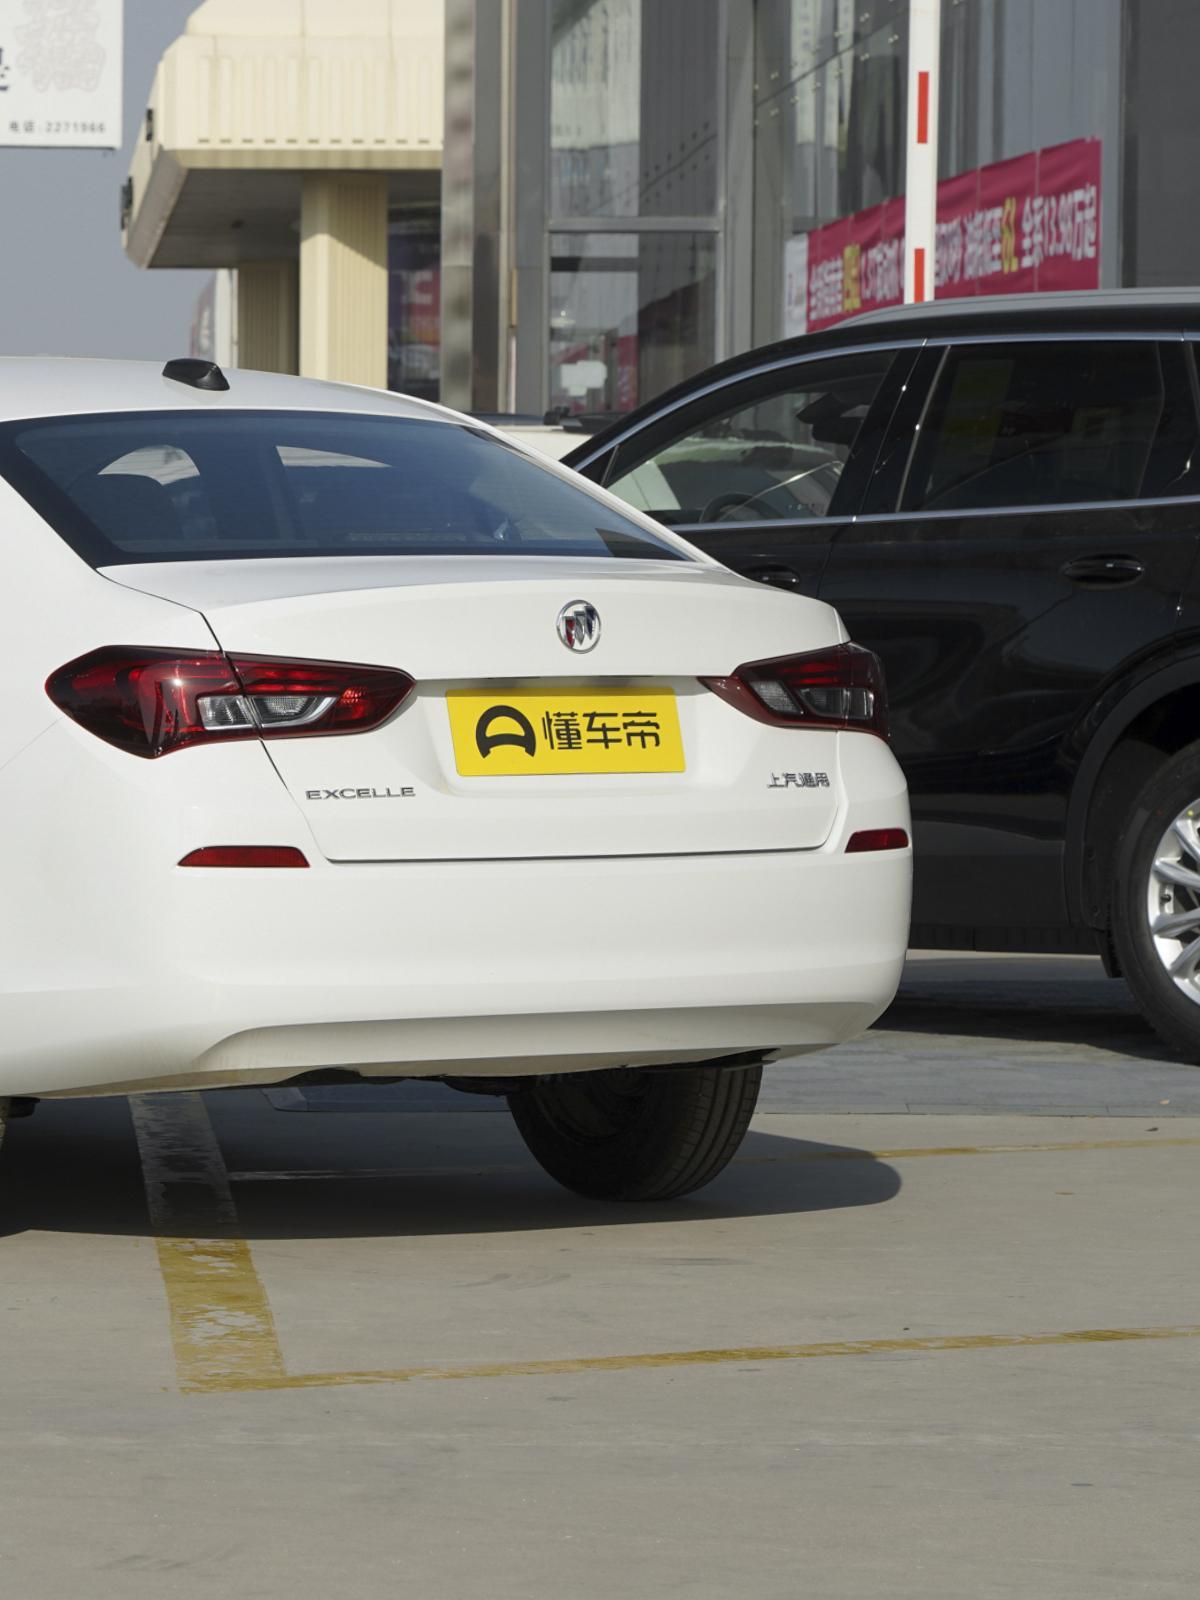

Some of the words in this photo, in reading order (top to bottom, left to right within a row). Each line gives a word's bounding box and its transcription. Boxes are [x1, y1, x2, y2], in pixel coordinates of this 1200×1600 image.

[541, 710, 661, 751] 懂车帝
[767, 771, 831, 789] 上汽通用
[305, 786, 416, 801] EXCELLE
